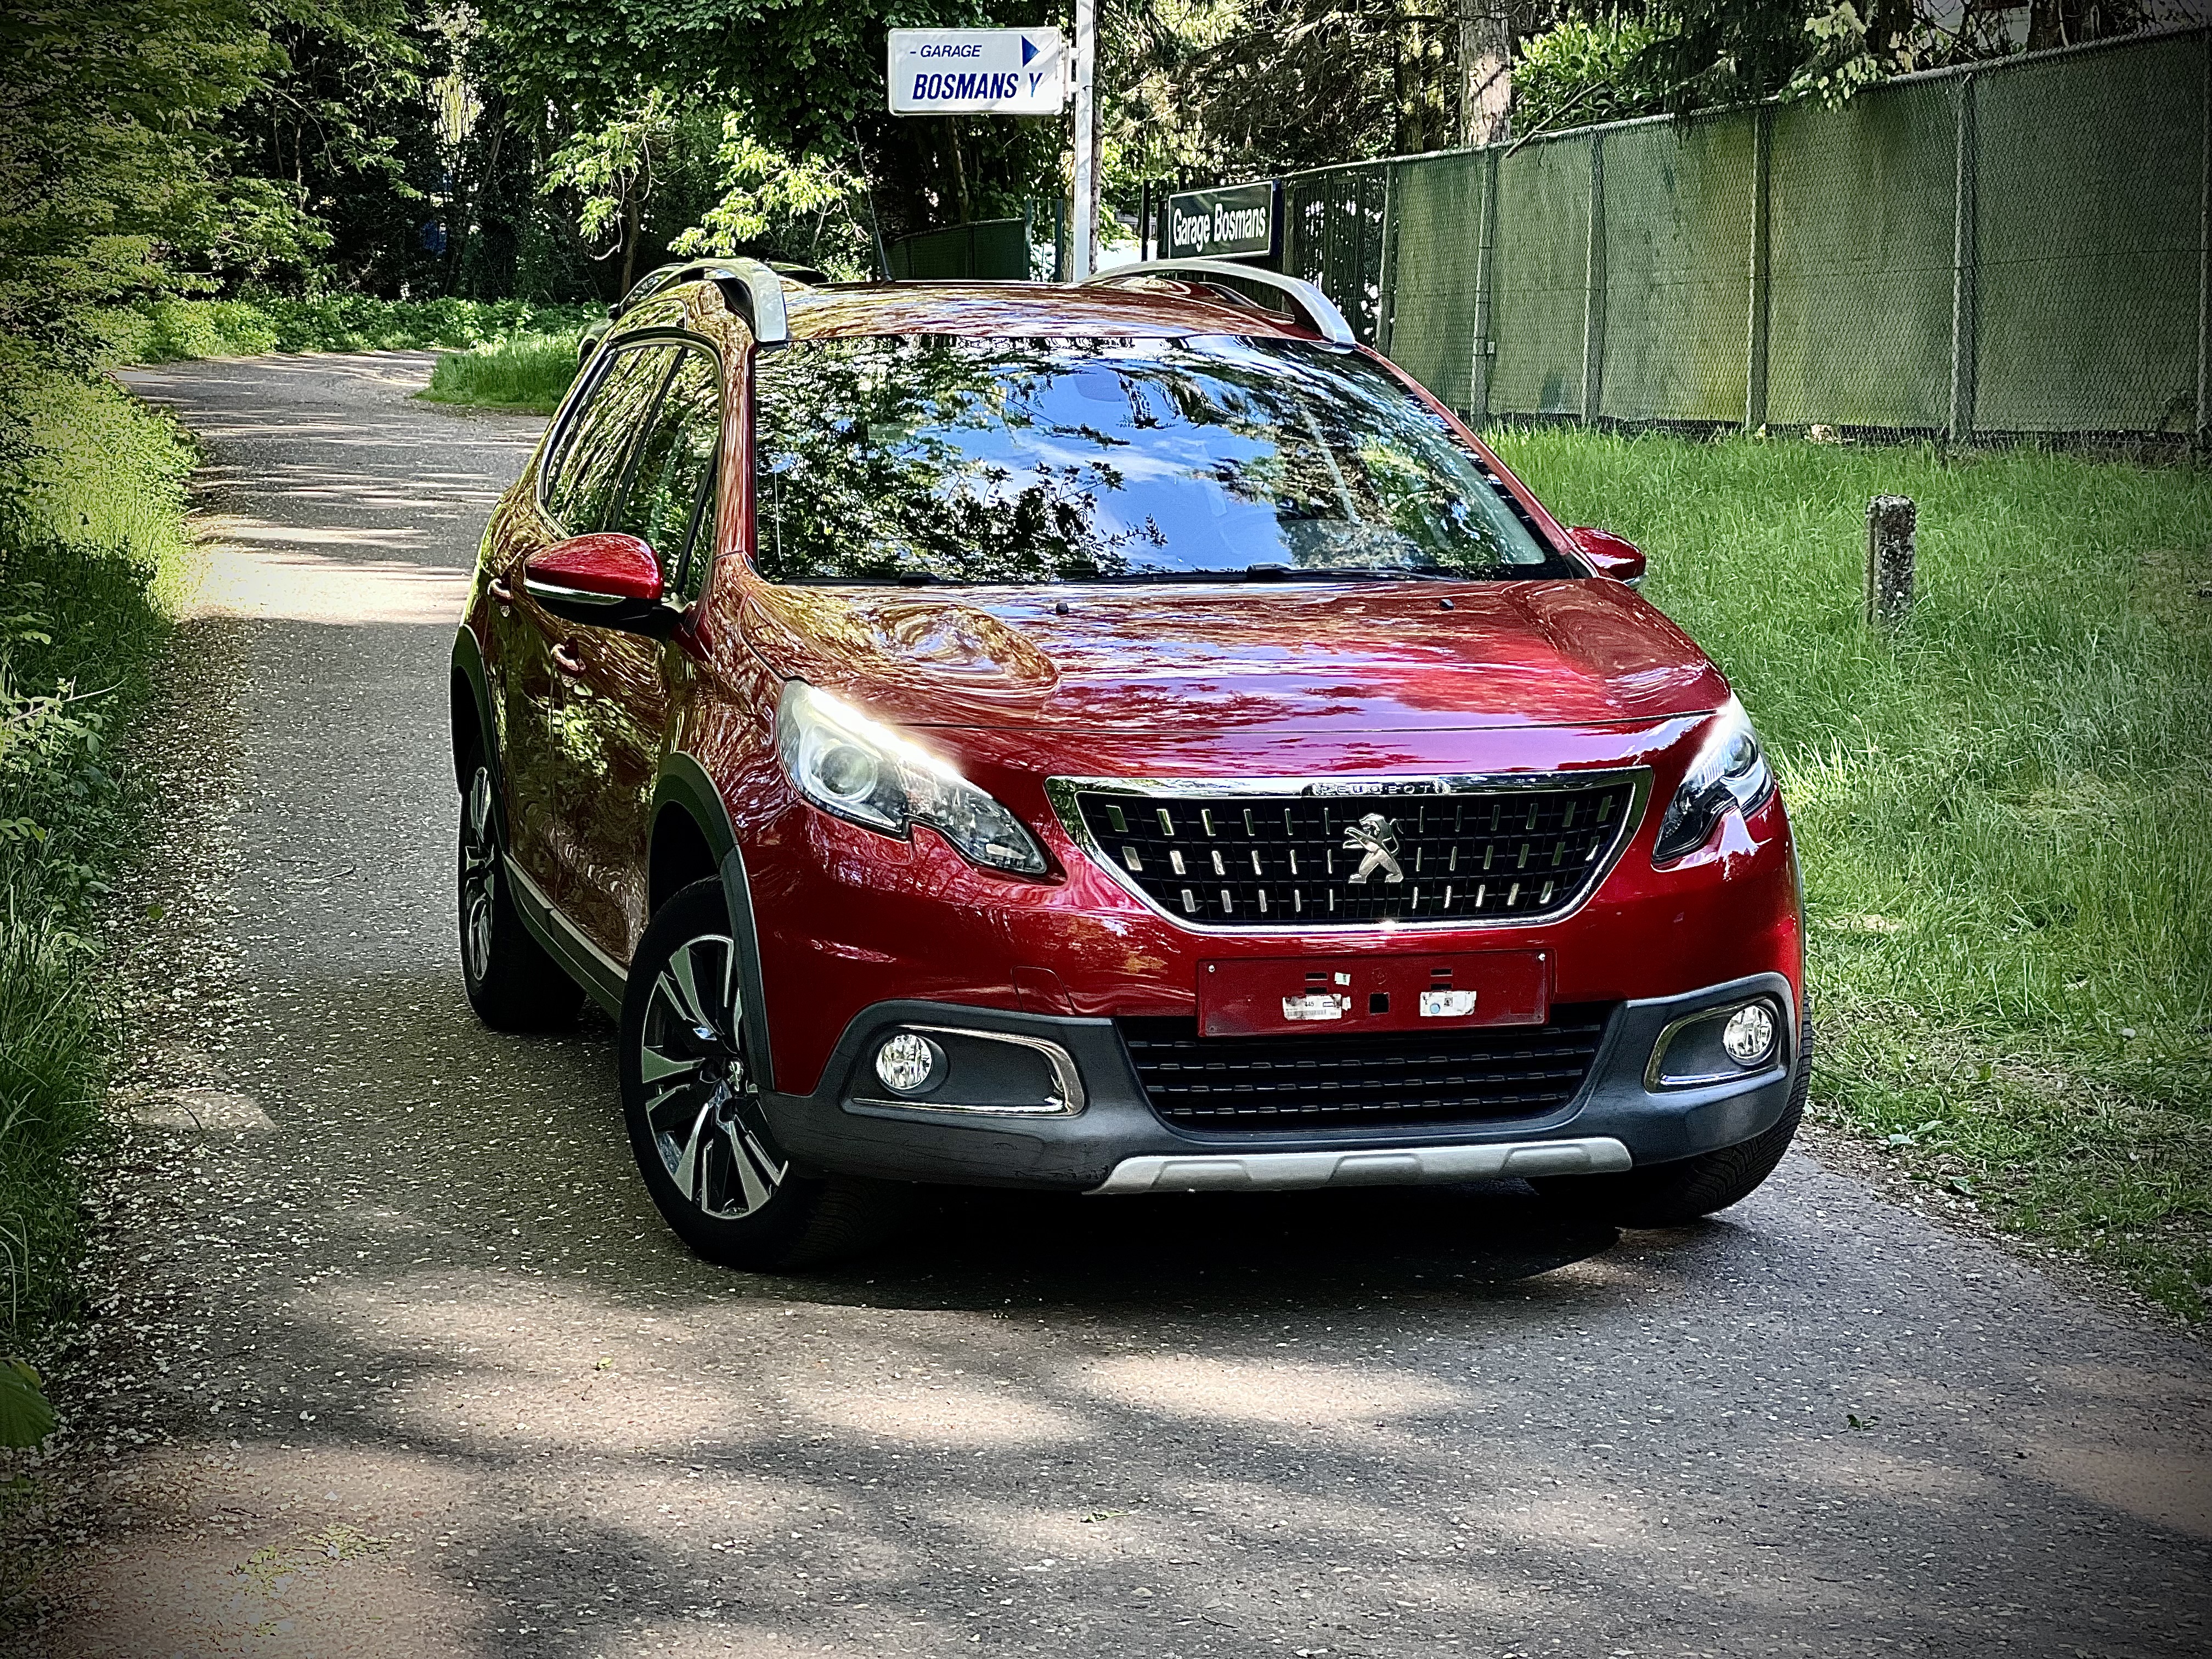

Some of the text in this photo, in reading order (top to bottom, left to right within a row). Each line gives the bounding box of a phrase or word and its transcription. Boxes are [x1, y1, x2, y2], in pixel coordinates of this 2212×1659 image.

[920, 44, 982, 58] GARAGE
[912, 72, 1042, 100] BOSMANS Y
[1173, 203, 1266, 252] Garage Bosmans
